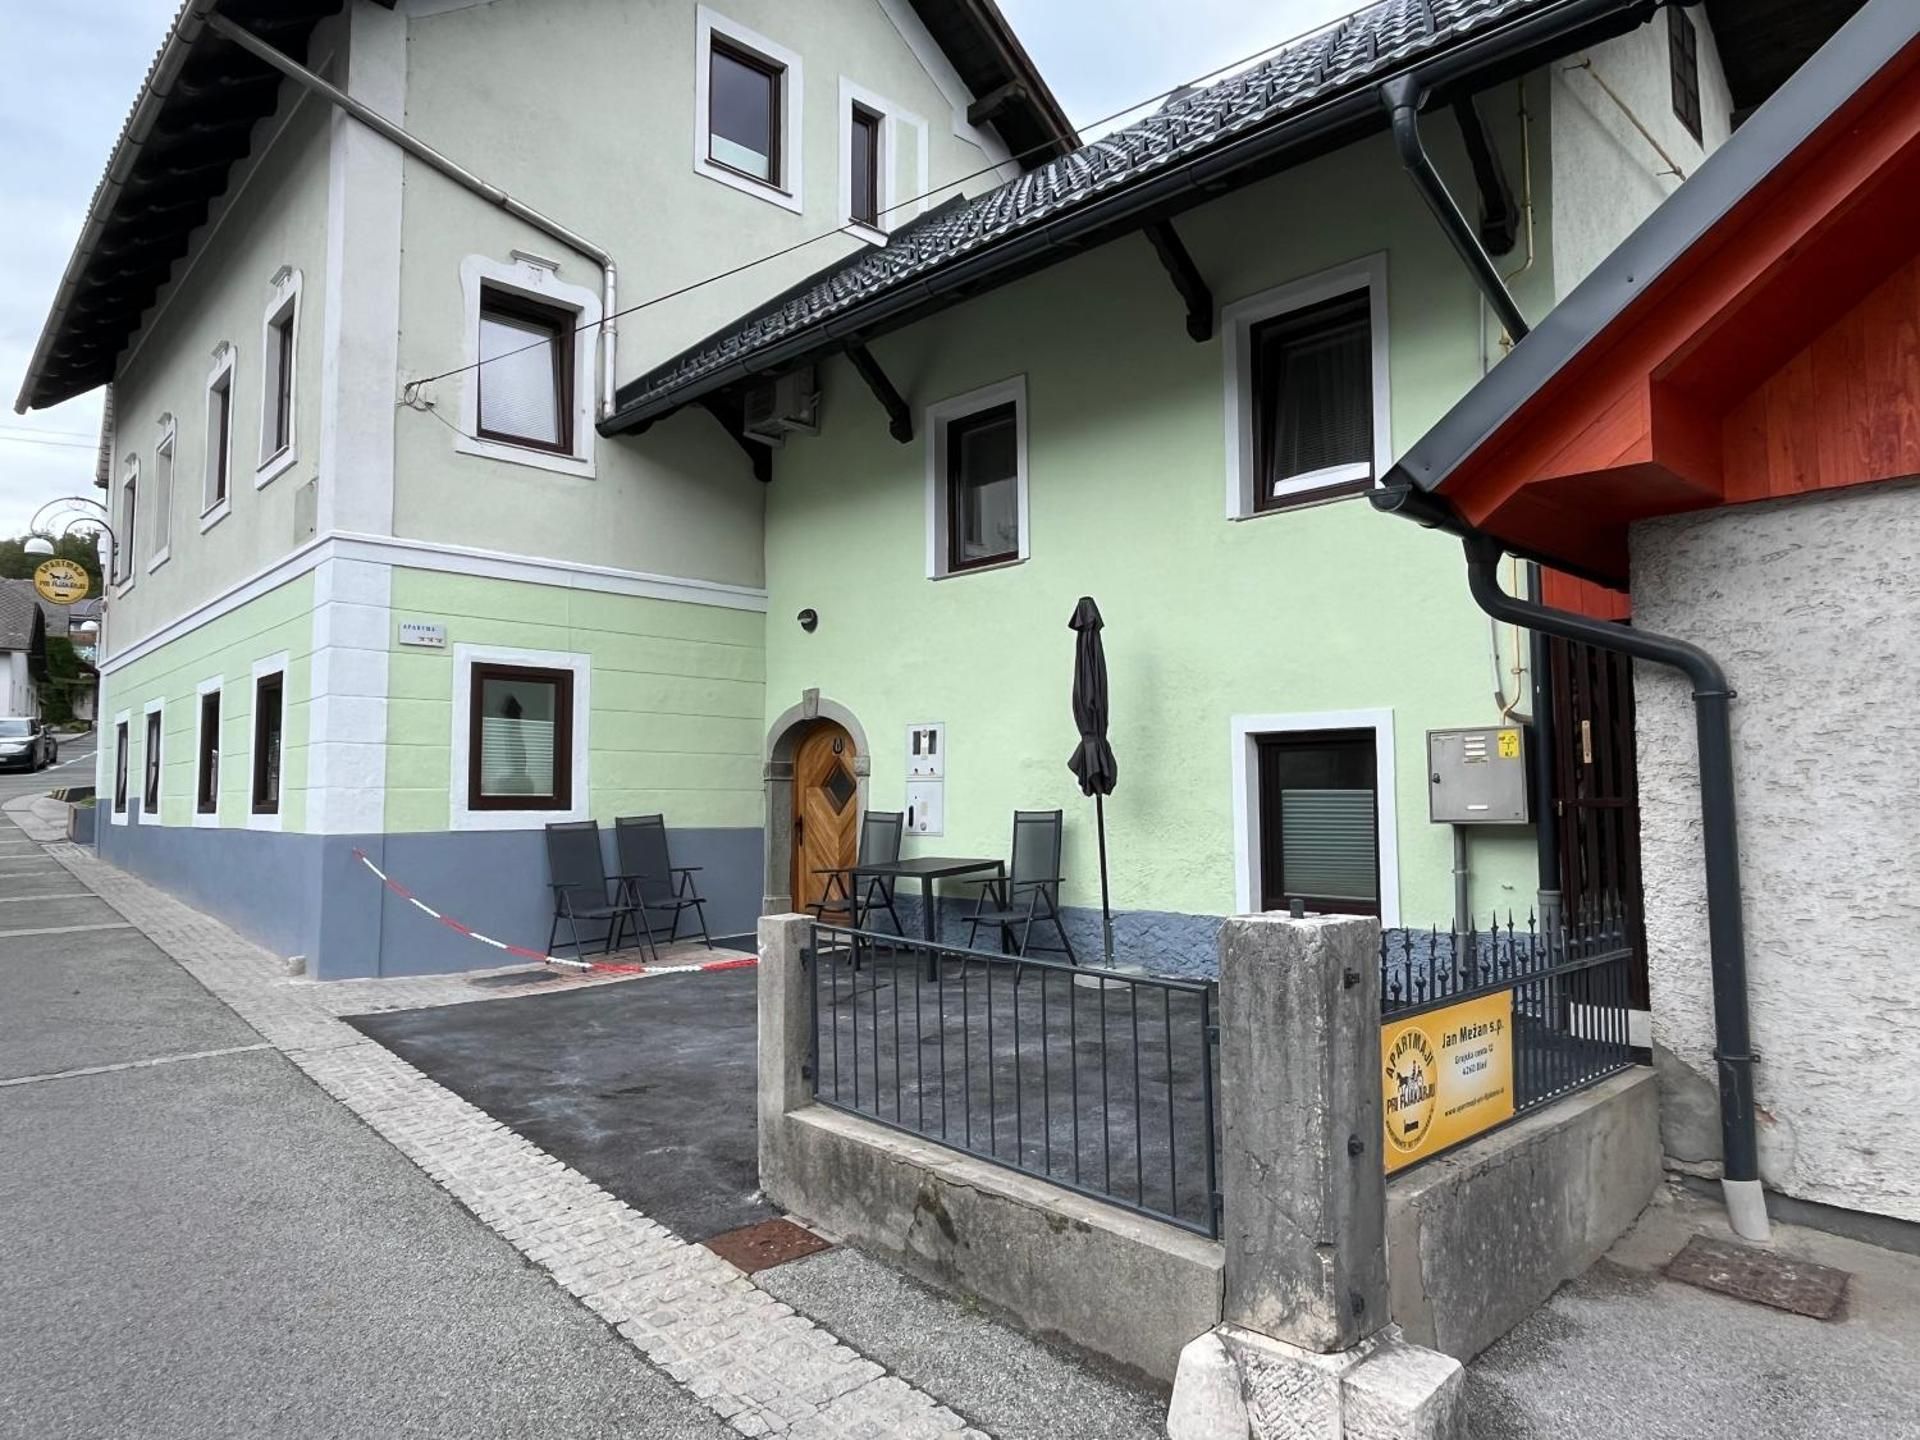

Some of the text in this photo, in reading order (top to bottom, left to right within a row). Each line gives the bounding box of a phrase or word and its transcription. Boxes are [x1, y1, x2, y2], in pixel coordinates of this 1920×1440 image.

[1442, 1018, 1504, 1048] Jan Mežan s.p.
[1386, 1033, 1433, 1079] APARTMAJI
